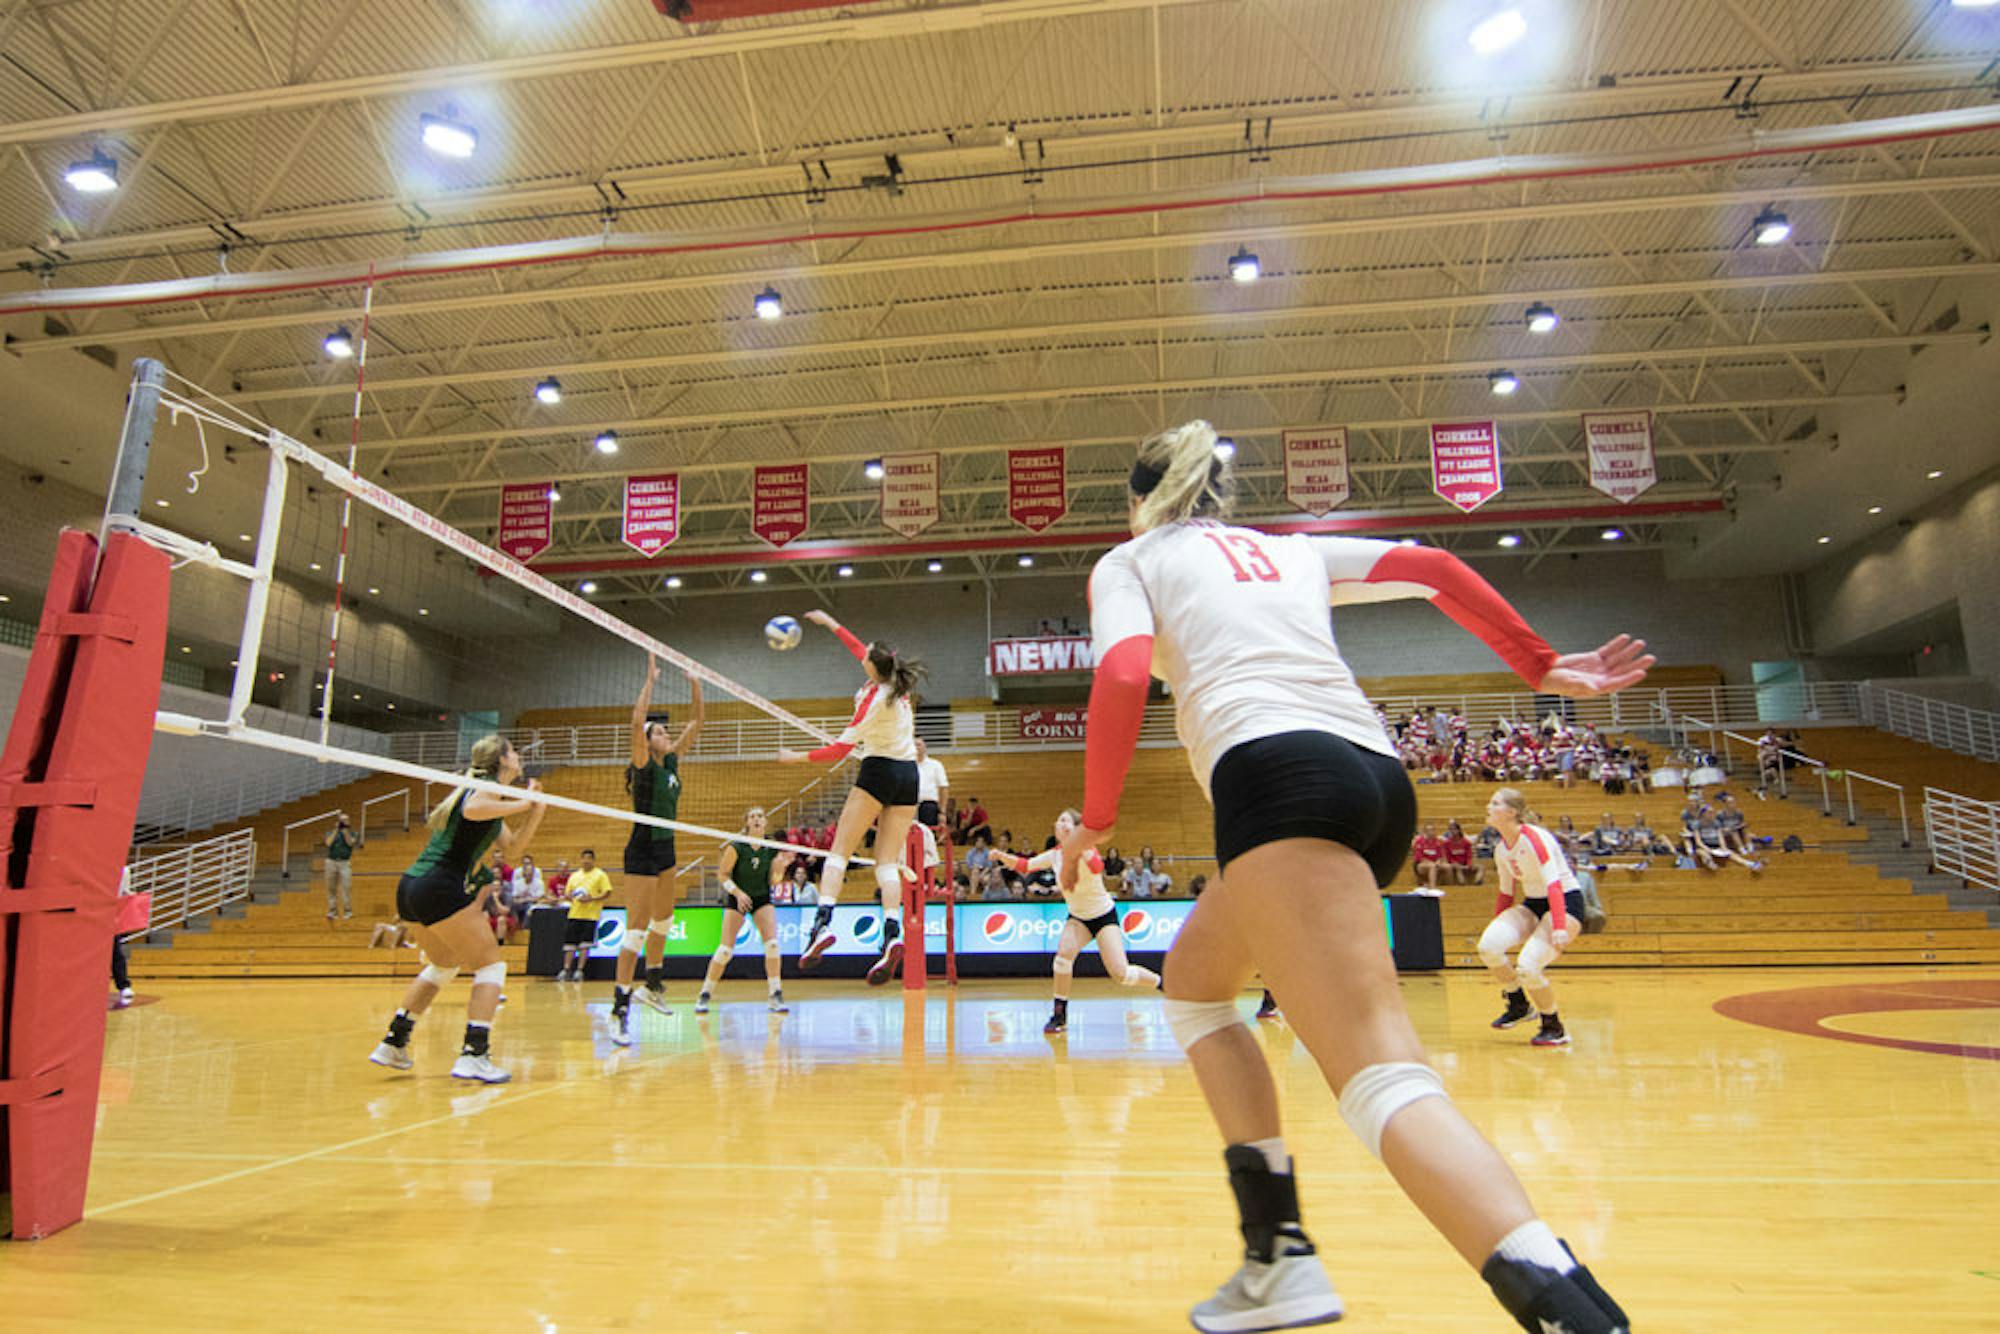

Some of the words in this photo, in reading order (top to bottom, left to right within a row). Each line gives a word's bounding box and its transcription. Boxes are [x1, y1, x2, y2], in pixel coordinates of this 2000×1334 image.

[1589, 421, 1646, 434] CORNELL
[1435, 429, 1491, 443] CORNELL
[1289, 438, 1342, 451] CORNELL
[1011, 455, 1060, 469] CORNELL
[887, 464, 934, 476] CORNELL
[758, 472, 804, 485] CORNELL
[629, 480, 676, 493] CORNELL
[1203, 532, 1281, 582] 13
[994, 640, 1095, 673] NEWM
[1018, 919, 1064, 939] pep
